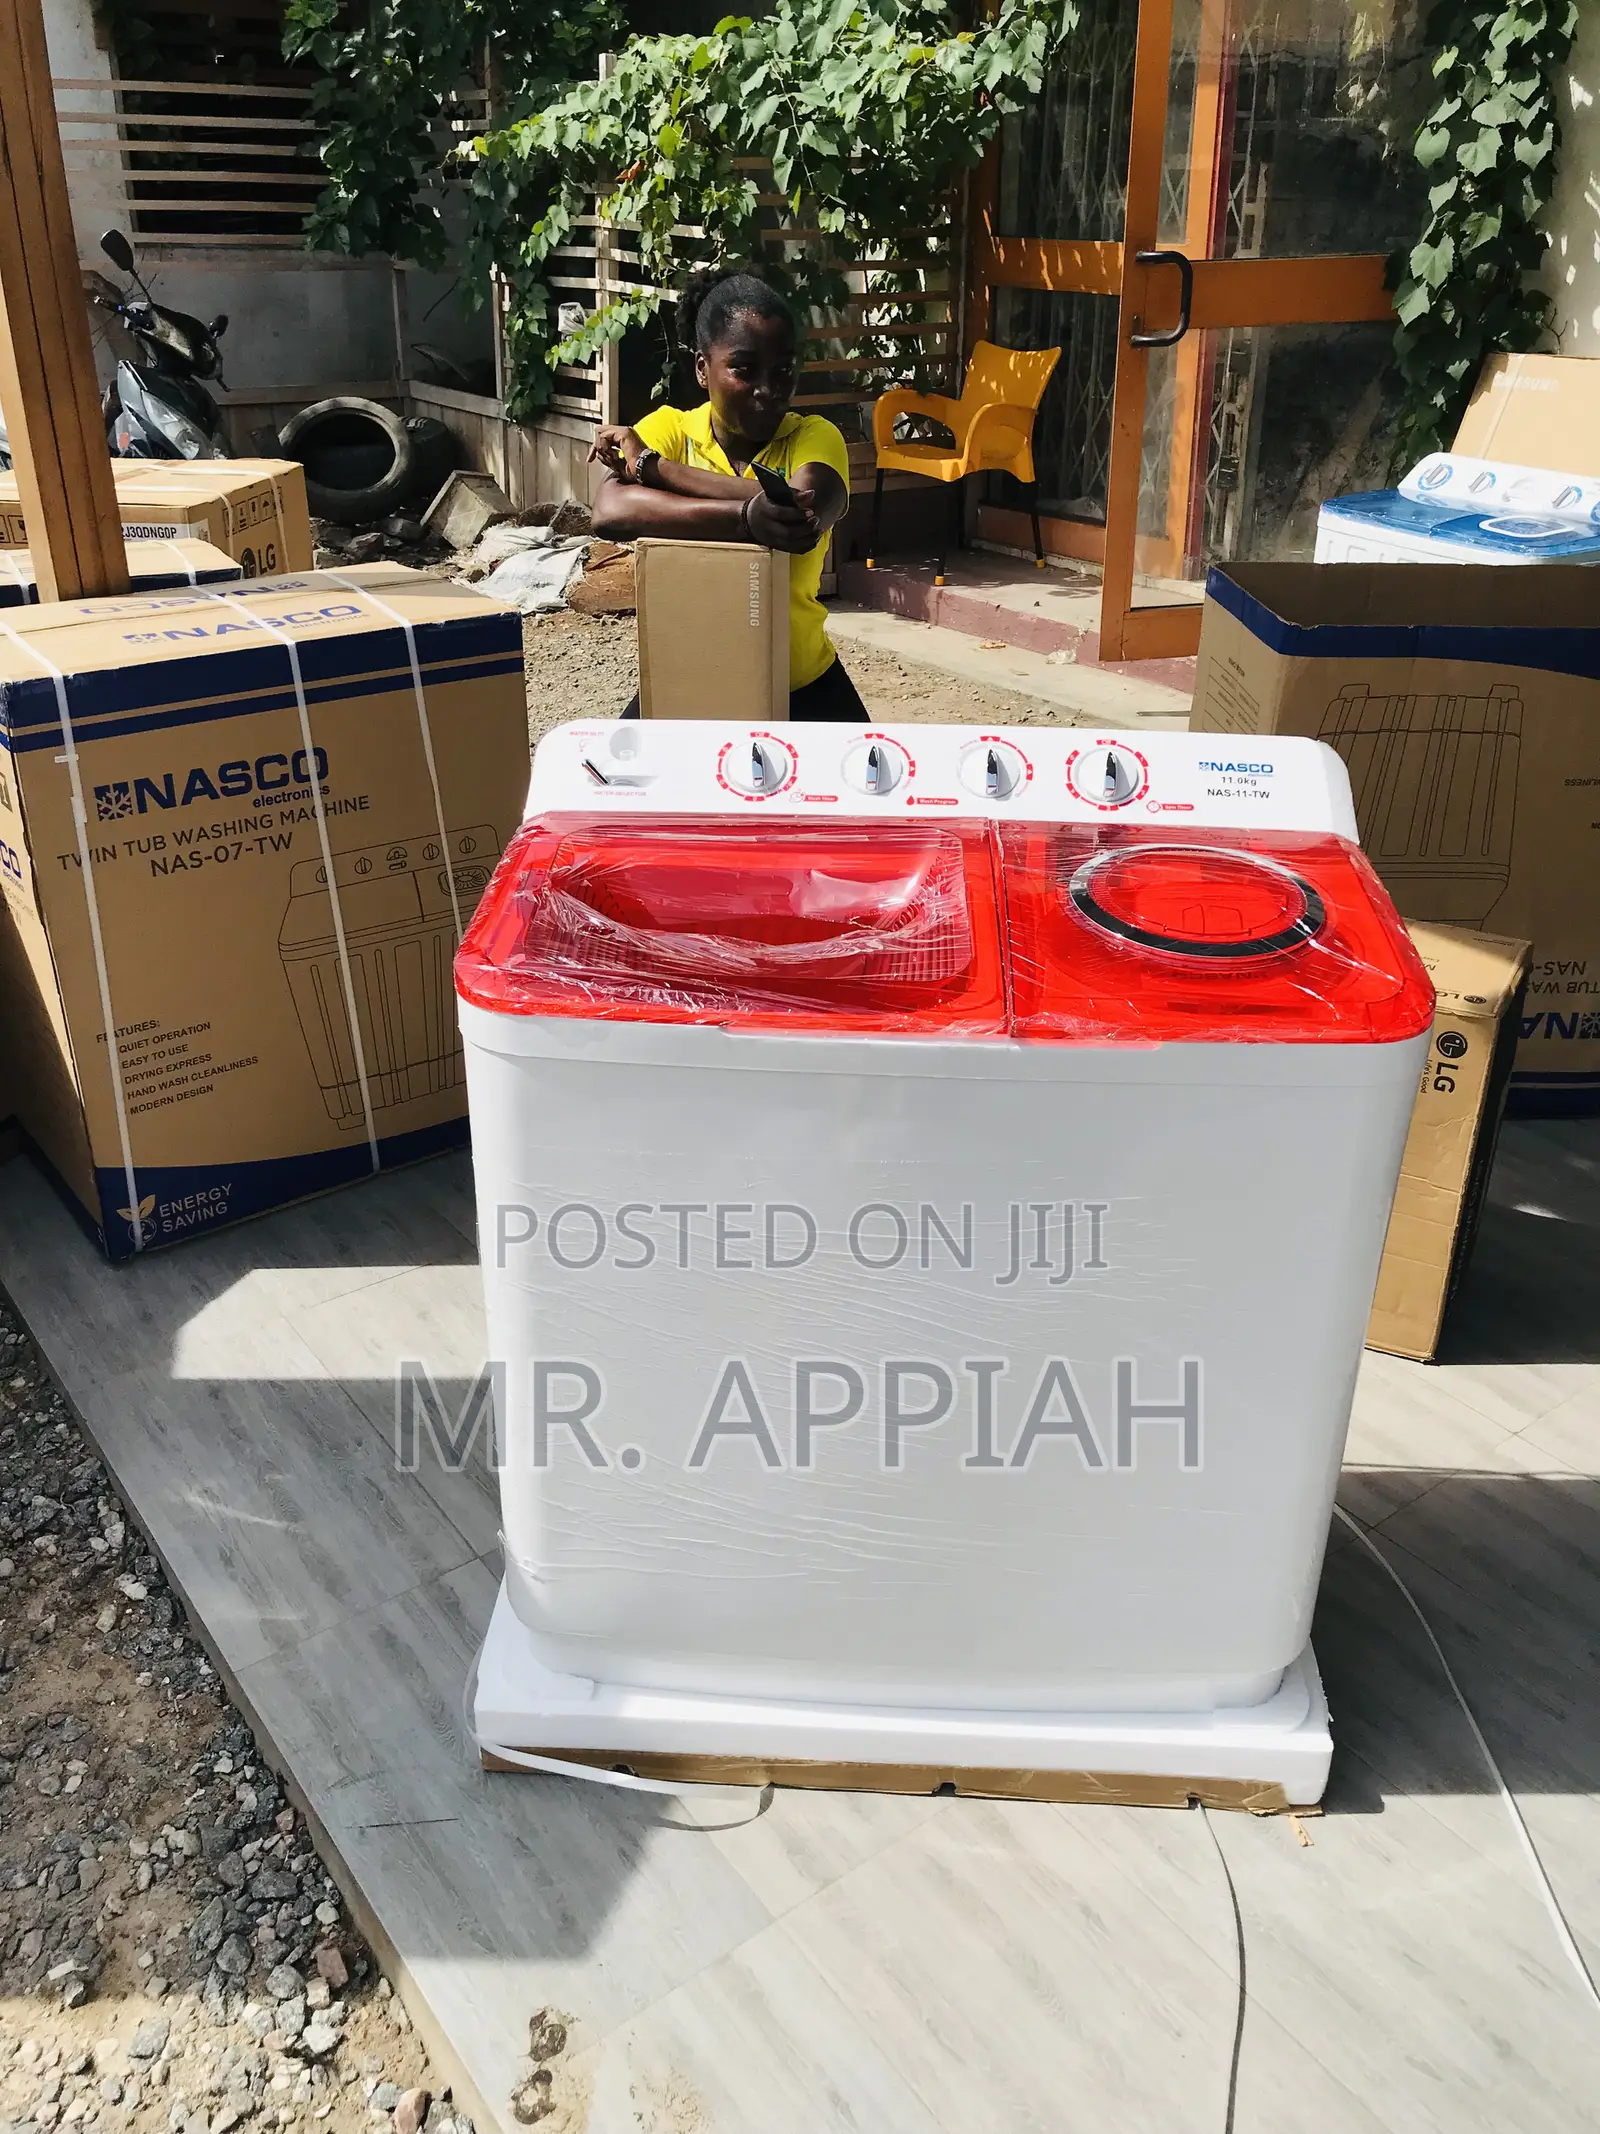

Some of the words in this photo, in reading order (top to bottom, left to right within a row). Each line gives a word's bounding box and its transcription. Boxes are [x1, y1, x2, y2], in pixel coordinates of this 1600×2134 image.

[258, 543, 276, 574] LG
[749, 562, 760, 627] SAMSUNG
[162, 604, 363, 640] NASCO
[133, 746, 329, 814] NASCO
[1210, 762, 1274, 774] NASCO
[1221, 776, 1257, 786] 11.0kg
[1207, 788, 1270, 799] NAS-11-TW
[123, 836, 167, 854] TUB
[172, 813, 274, 847] WASHING
[150, 831, 293, 877] NAS-07-TW
[119, 1038, 149, 1054] QUIET
[152, 1022, 211, 1044] OPERATION
[121, 1054, 149, 1069] EASY
[152, 1050, 166, 1061] TO
[168, 1044, 189, 1056] USE
[124, 1067, 164, 1085] DRYING
[165, 1053, 213, 1073] EXPRESS
[127, 1084, 157, 1100] HAND
[158, 1075, 189, 1091] WASH
[191, 1055, 259, 1082] CLEANLINESS
[1419, 1076, 1431, 1094] Good
[1433, 1061, 1459, 1094] LG
[130, 1096, 174, 1115] MODERN
[176, 1084, 214, 1101] DESIGN
[159, 1183, 232, 1217] ENERGY
[162, 1201, 228, 1233] SAVING
